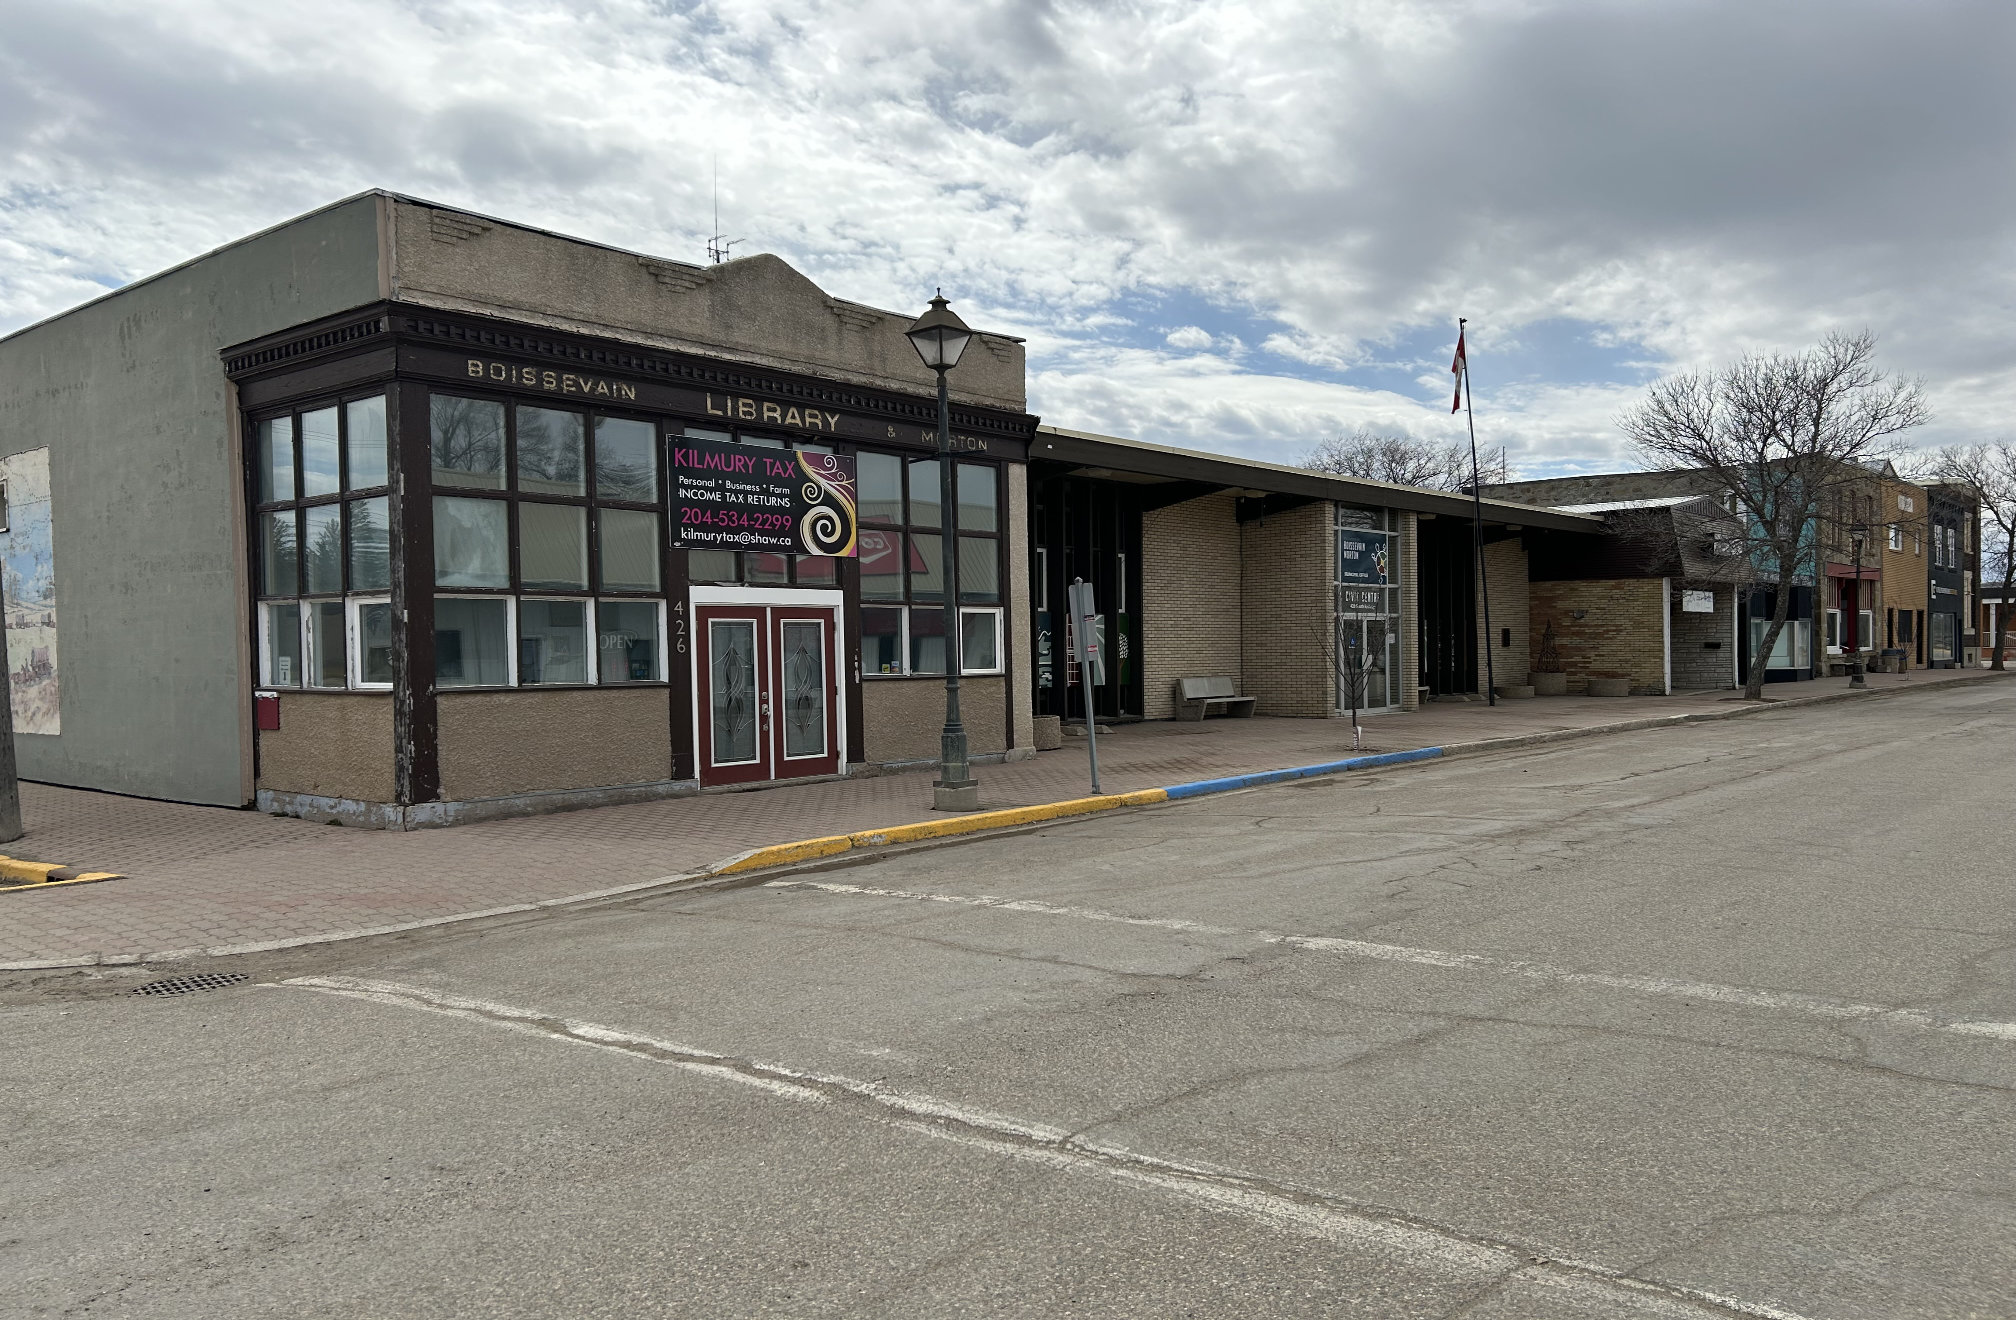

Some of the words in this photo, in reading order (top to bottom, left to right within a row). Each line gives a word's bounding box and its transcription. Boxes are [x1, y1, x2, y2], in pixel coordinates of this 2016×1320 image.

[467, 359, 636, 400] BOISSEVAIN
[706, 392, 841, 432] LIBRARY
[887, 425, 896, 438] &
[674, 447, 756, 474] KILMURY
[763, 458, 796, 479] TAX
[678, 475, 715, 487] Personal
[725, 480, 760, 492] Business
[769, 485, 790, 495] Farm
[679, 488, 722, 502] INCOME
[724, 492, 745, 504] TAX
[747, 494, 791, 508] RETURNS
[681, 507, 793, 531] 204-534-2299
[680, 527, 792, 546] kilmurytax@shaw.ca
[673, 600, 686, 653] 426
[600, 634, 633, 649] OPEN
